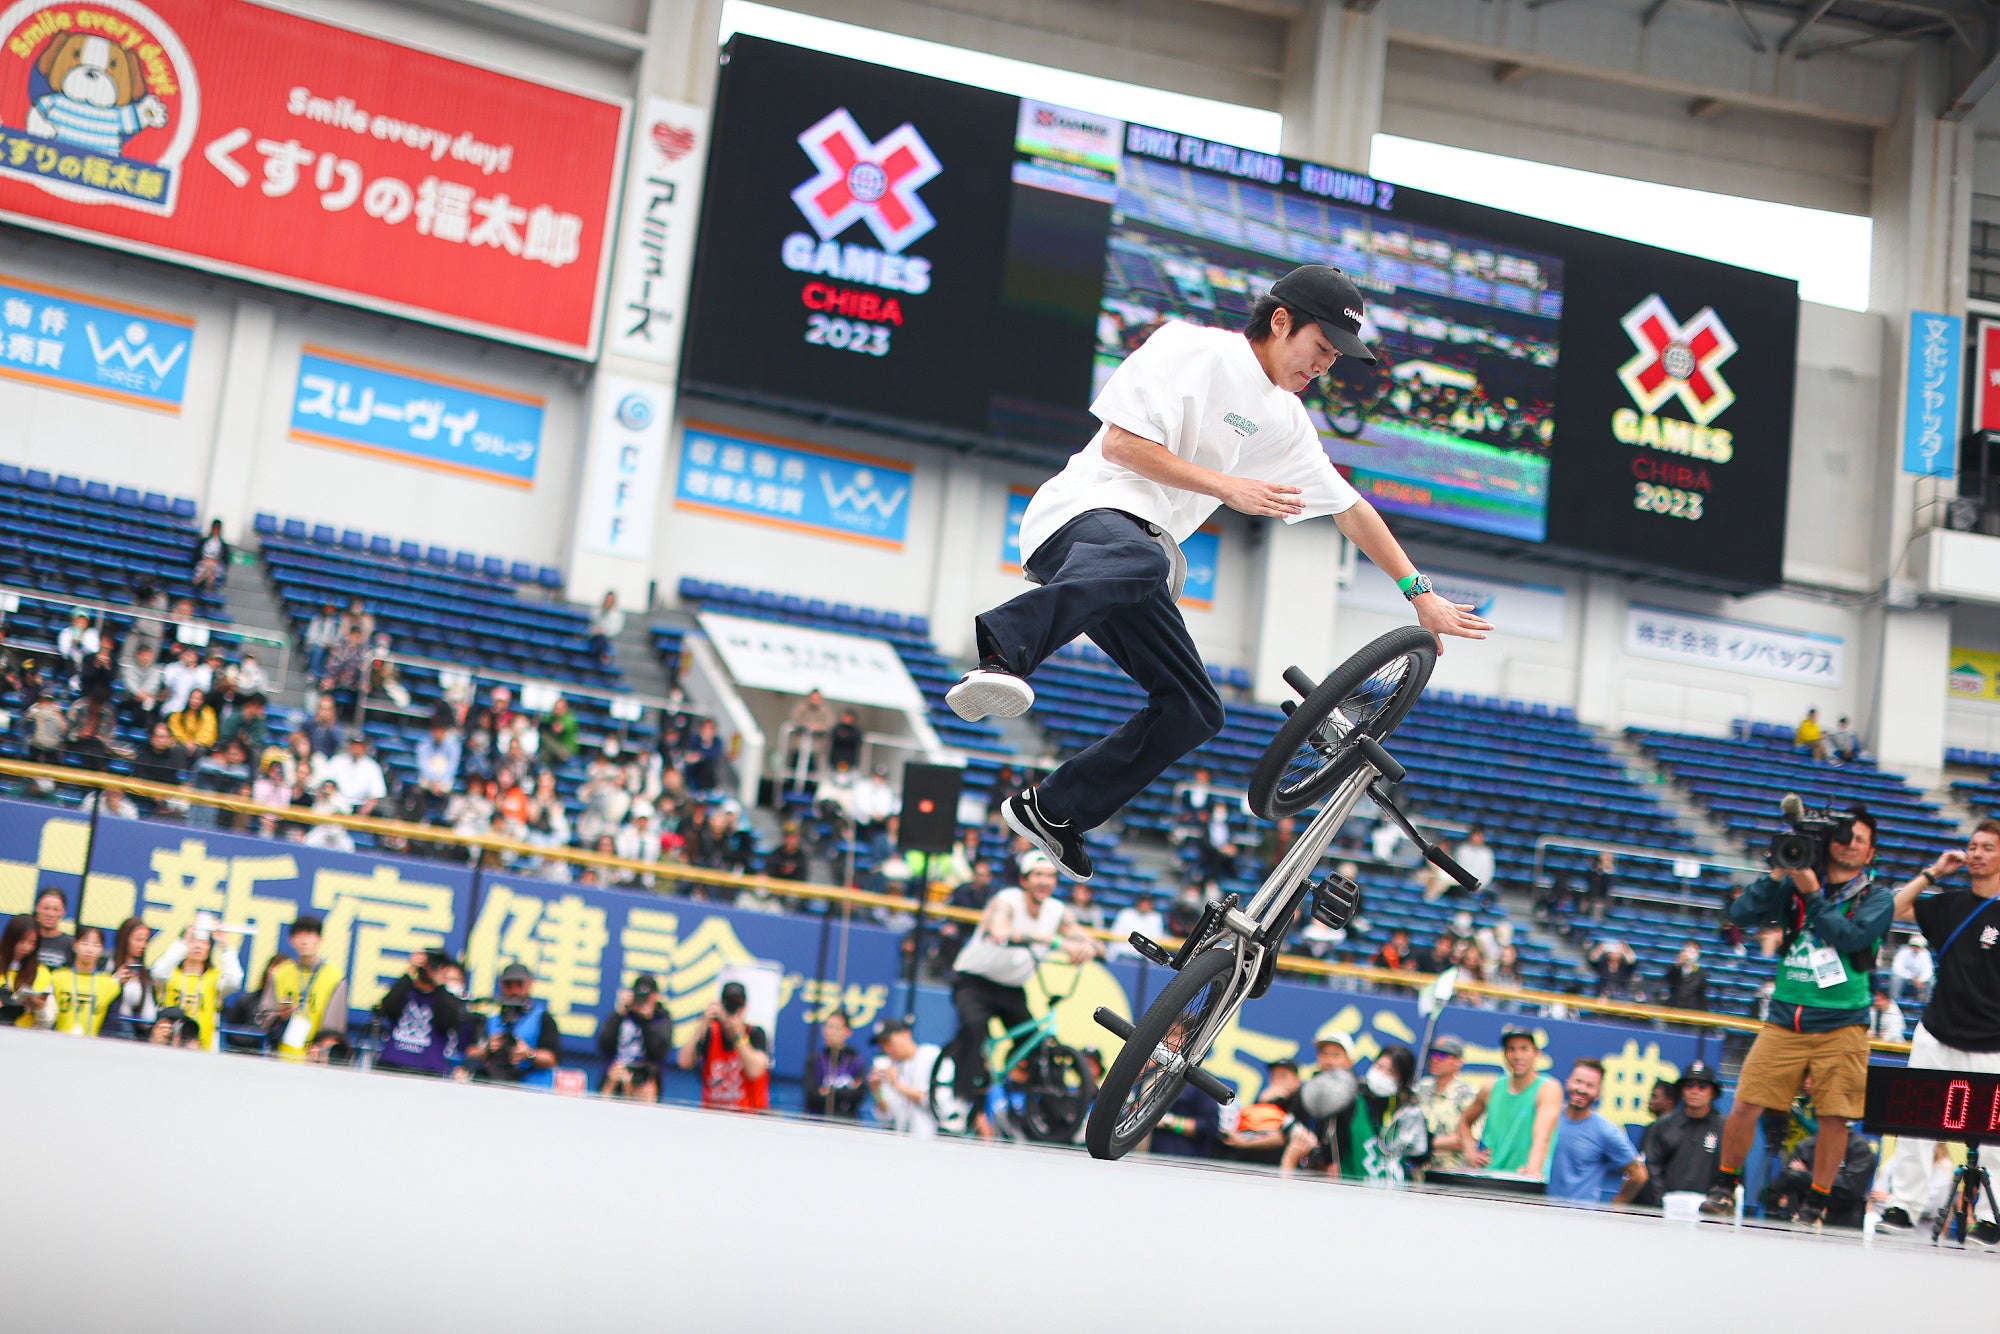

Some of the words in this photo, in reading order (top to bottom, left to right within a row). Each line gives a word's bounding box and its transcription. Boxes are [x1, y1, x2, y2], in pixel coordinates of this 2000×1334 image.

[9, 10, 72, 59] Smile
[75, 9, 145, 50] every
[287, 86, 371, 135] Smile
[369, 114, 454, 162] every
[450, 131, 515, 176] day!
[0, 133, 165, 199] すりの福太郎
[1127, 123, 1178, 161] BMX
[1178, 134, 1285, 185] FLATLAND
[1300, 162, 1377, 207] ROUND
[1376, 181, 1395, 211] 2
[203, 126, 584, 268] くすりの福太郎
[625, 176, 676, 341] アミューズ
[781, 231, 933, 295] GAMES
[802, 281, 904, 327] CHIBA
[0, 331, 66, 370] 売買
[804, 312, 892, 357] 2023
[1611, 407, 1735, 465] GAMES
[1631, 456, 1713, 494] CHIBA
[1632, 481, 1705, 521] 2023
